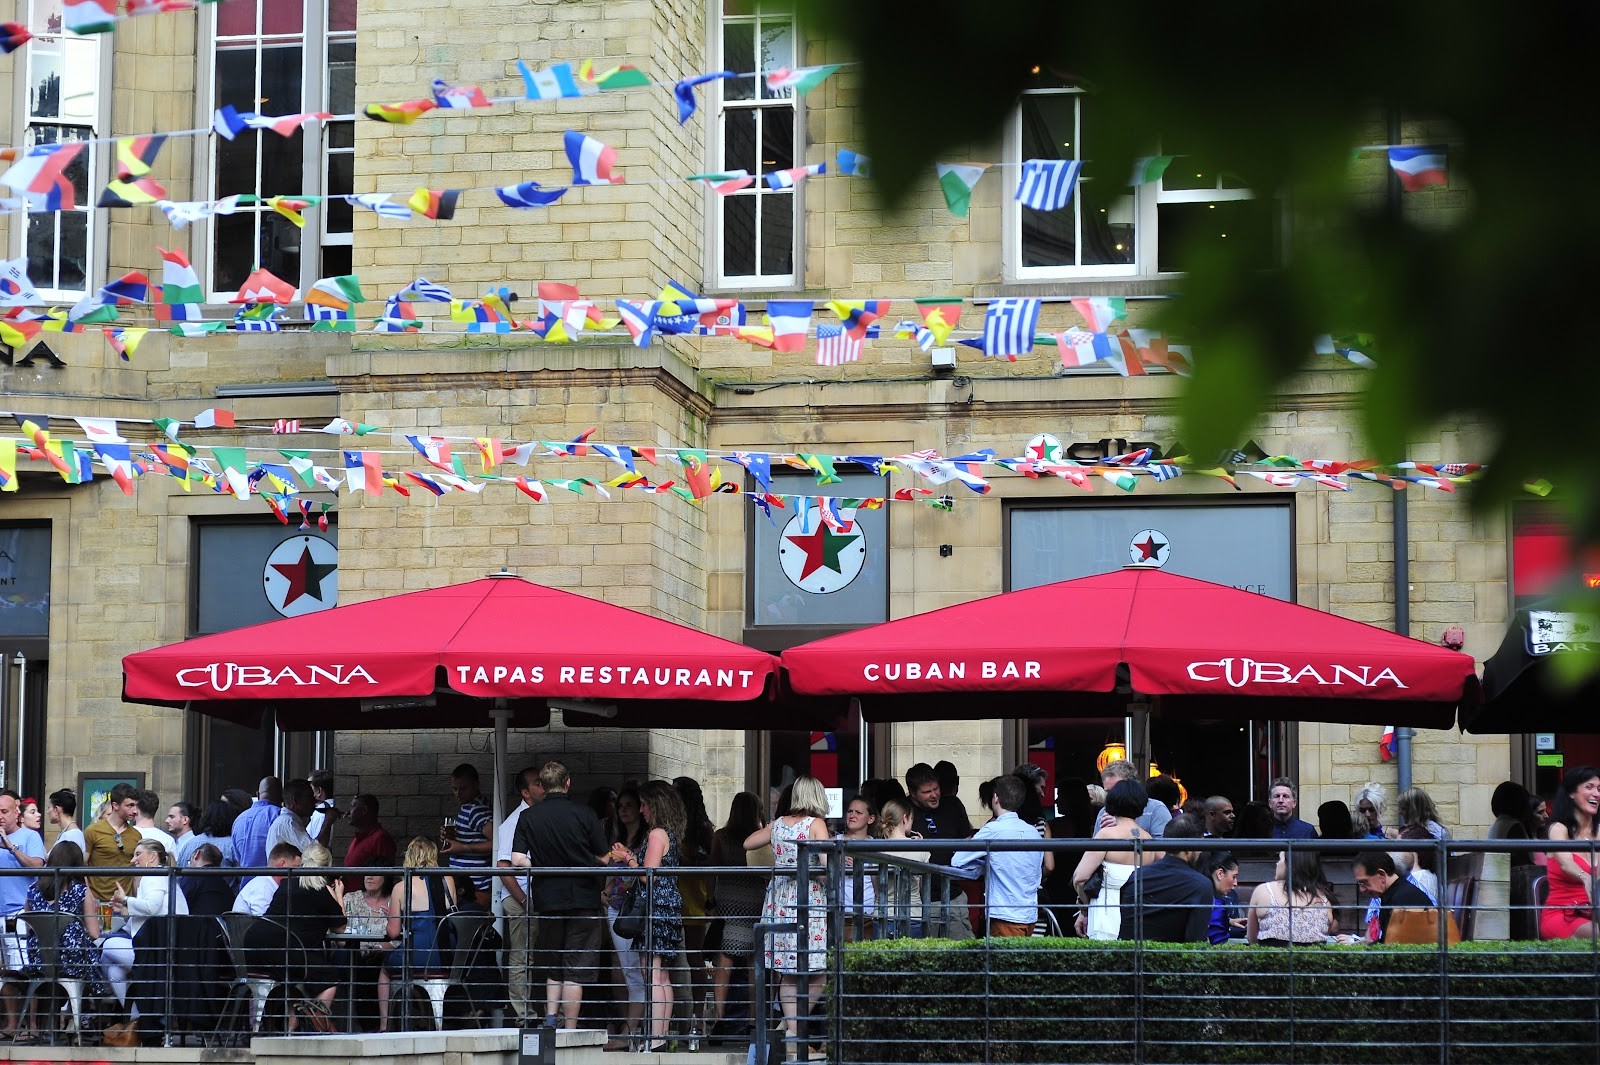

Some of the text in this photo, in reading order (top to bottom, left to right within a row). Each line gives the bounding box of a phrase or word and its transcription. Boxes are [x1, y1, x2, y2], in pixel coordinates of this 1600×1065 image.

[175, 662, 380, 692] CUBANA
[456, 666, 754, 688] TAPAS RESTAURANT
[863, 661, 1041, 681] CUBAN BAR
[1186, 657, 1410, 689] CUBANA
